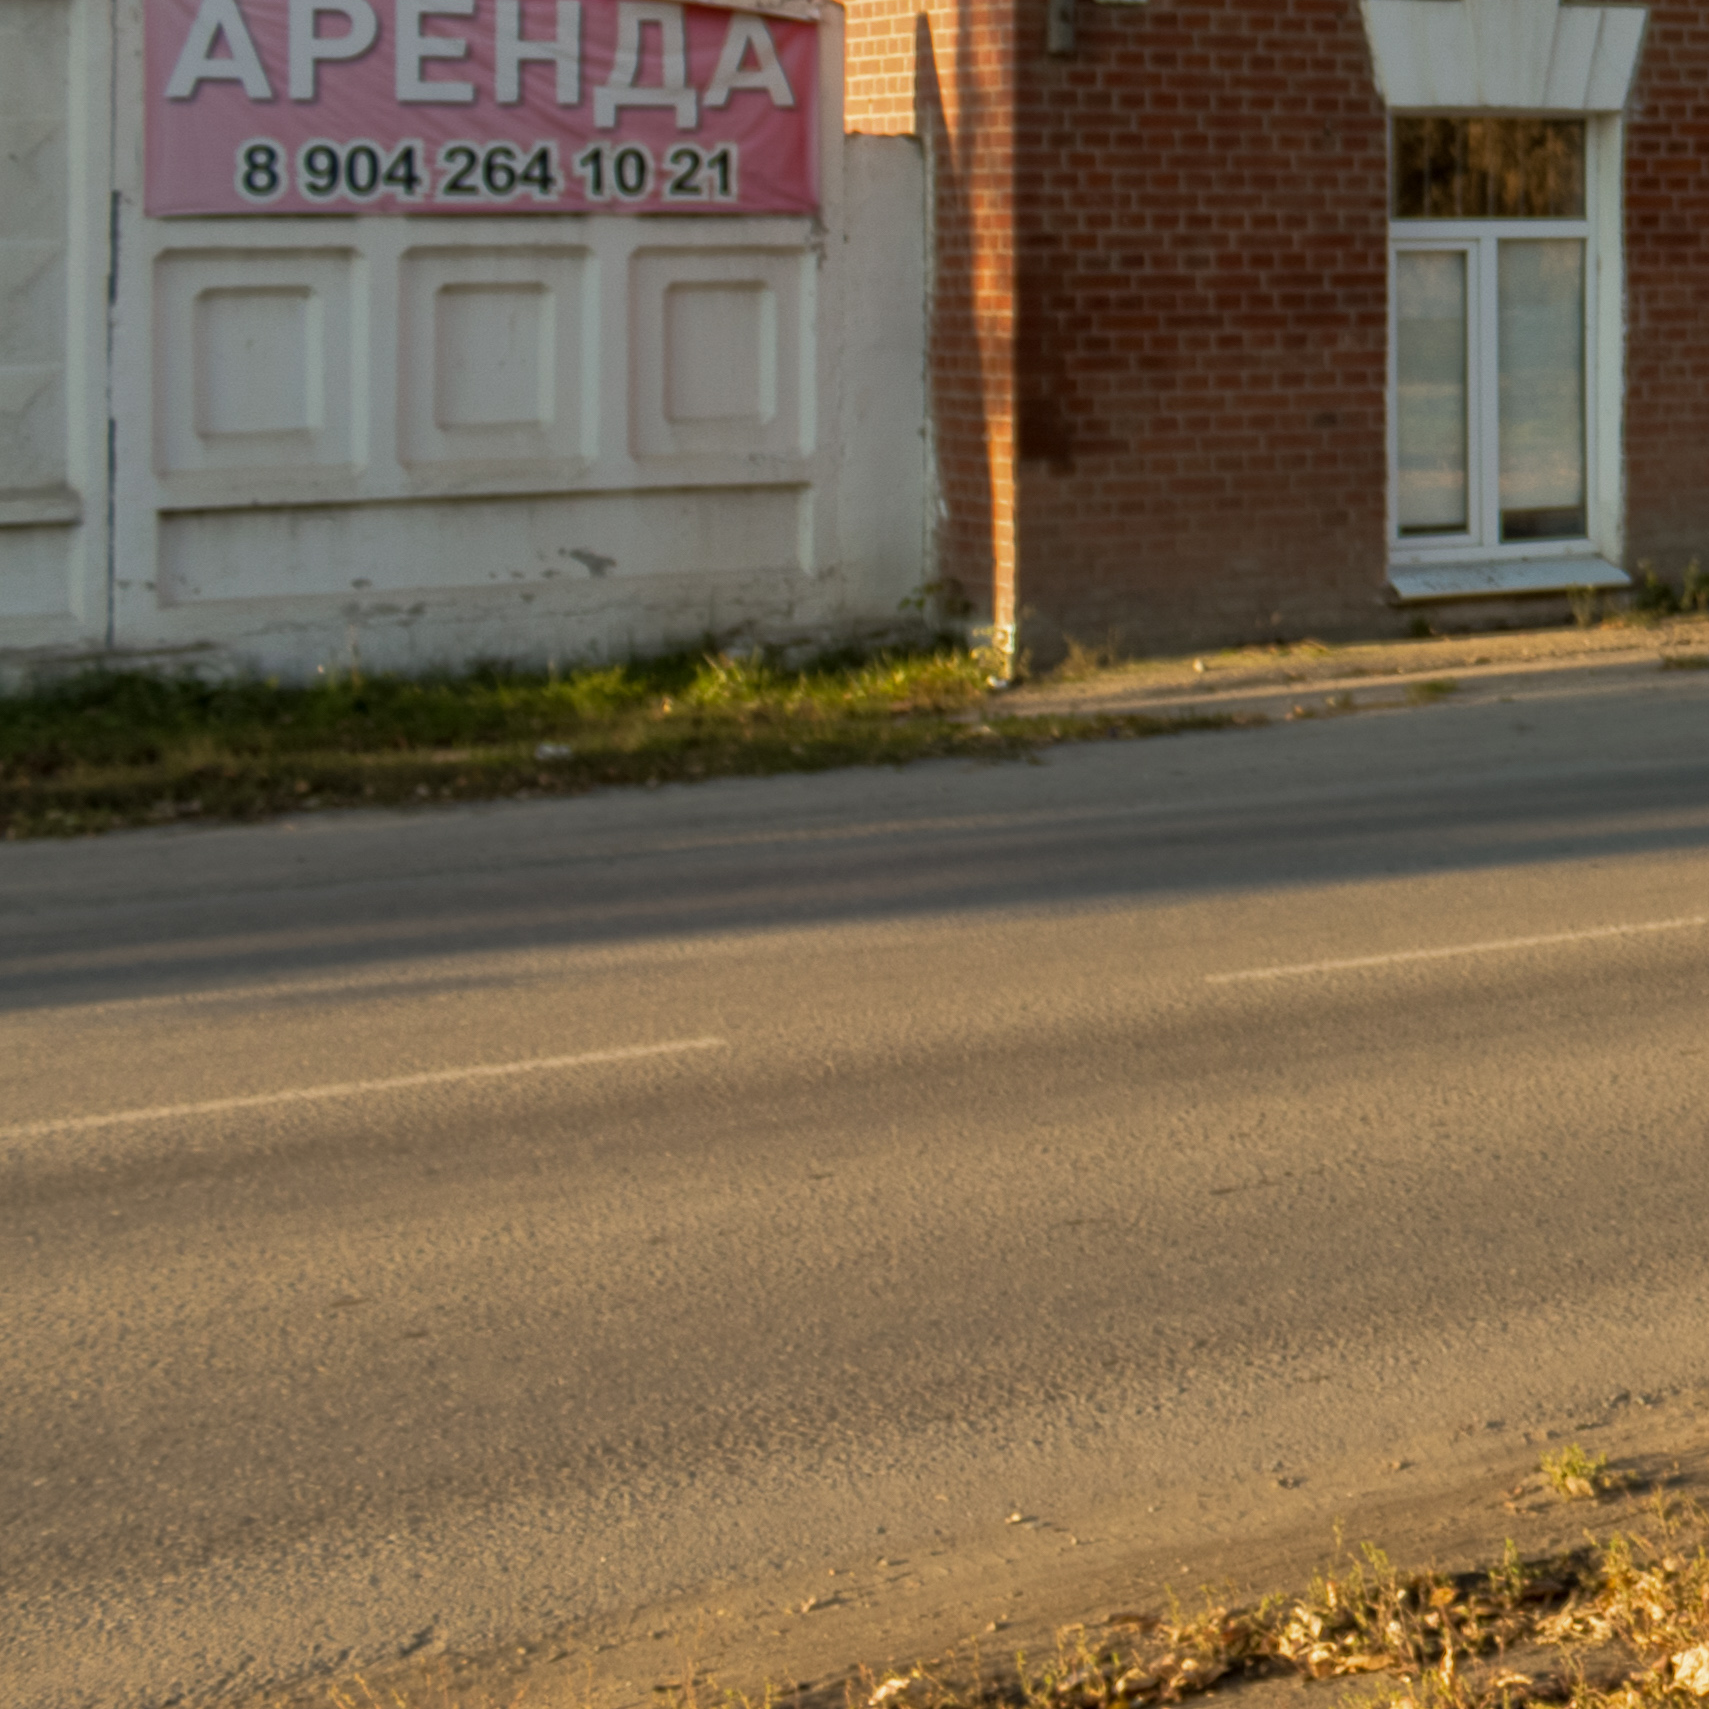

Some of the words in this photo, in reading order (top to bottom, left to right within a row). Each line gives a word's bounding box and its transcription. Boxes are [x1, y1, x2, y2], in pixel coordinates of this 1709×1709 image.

[238, 142, 282, 197] 8
[302, 144, 423, 198] 904
[441, 144, 557, 198] 264
[580, 145, 648, 199] 10
[667, 145, 739, 199] 21
